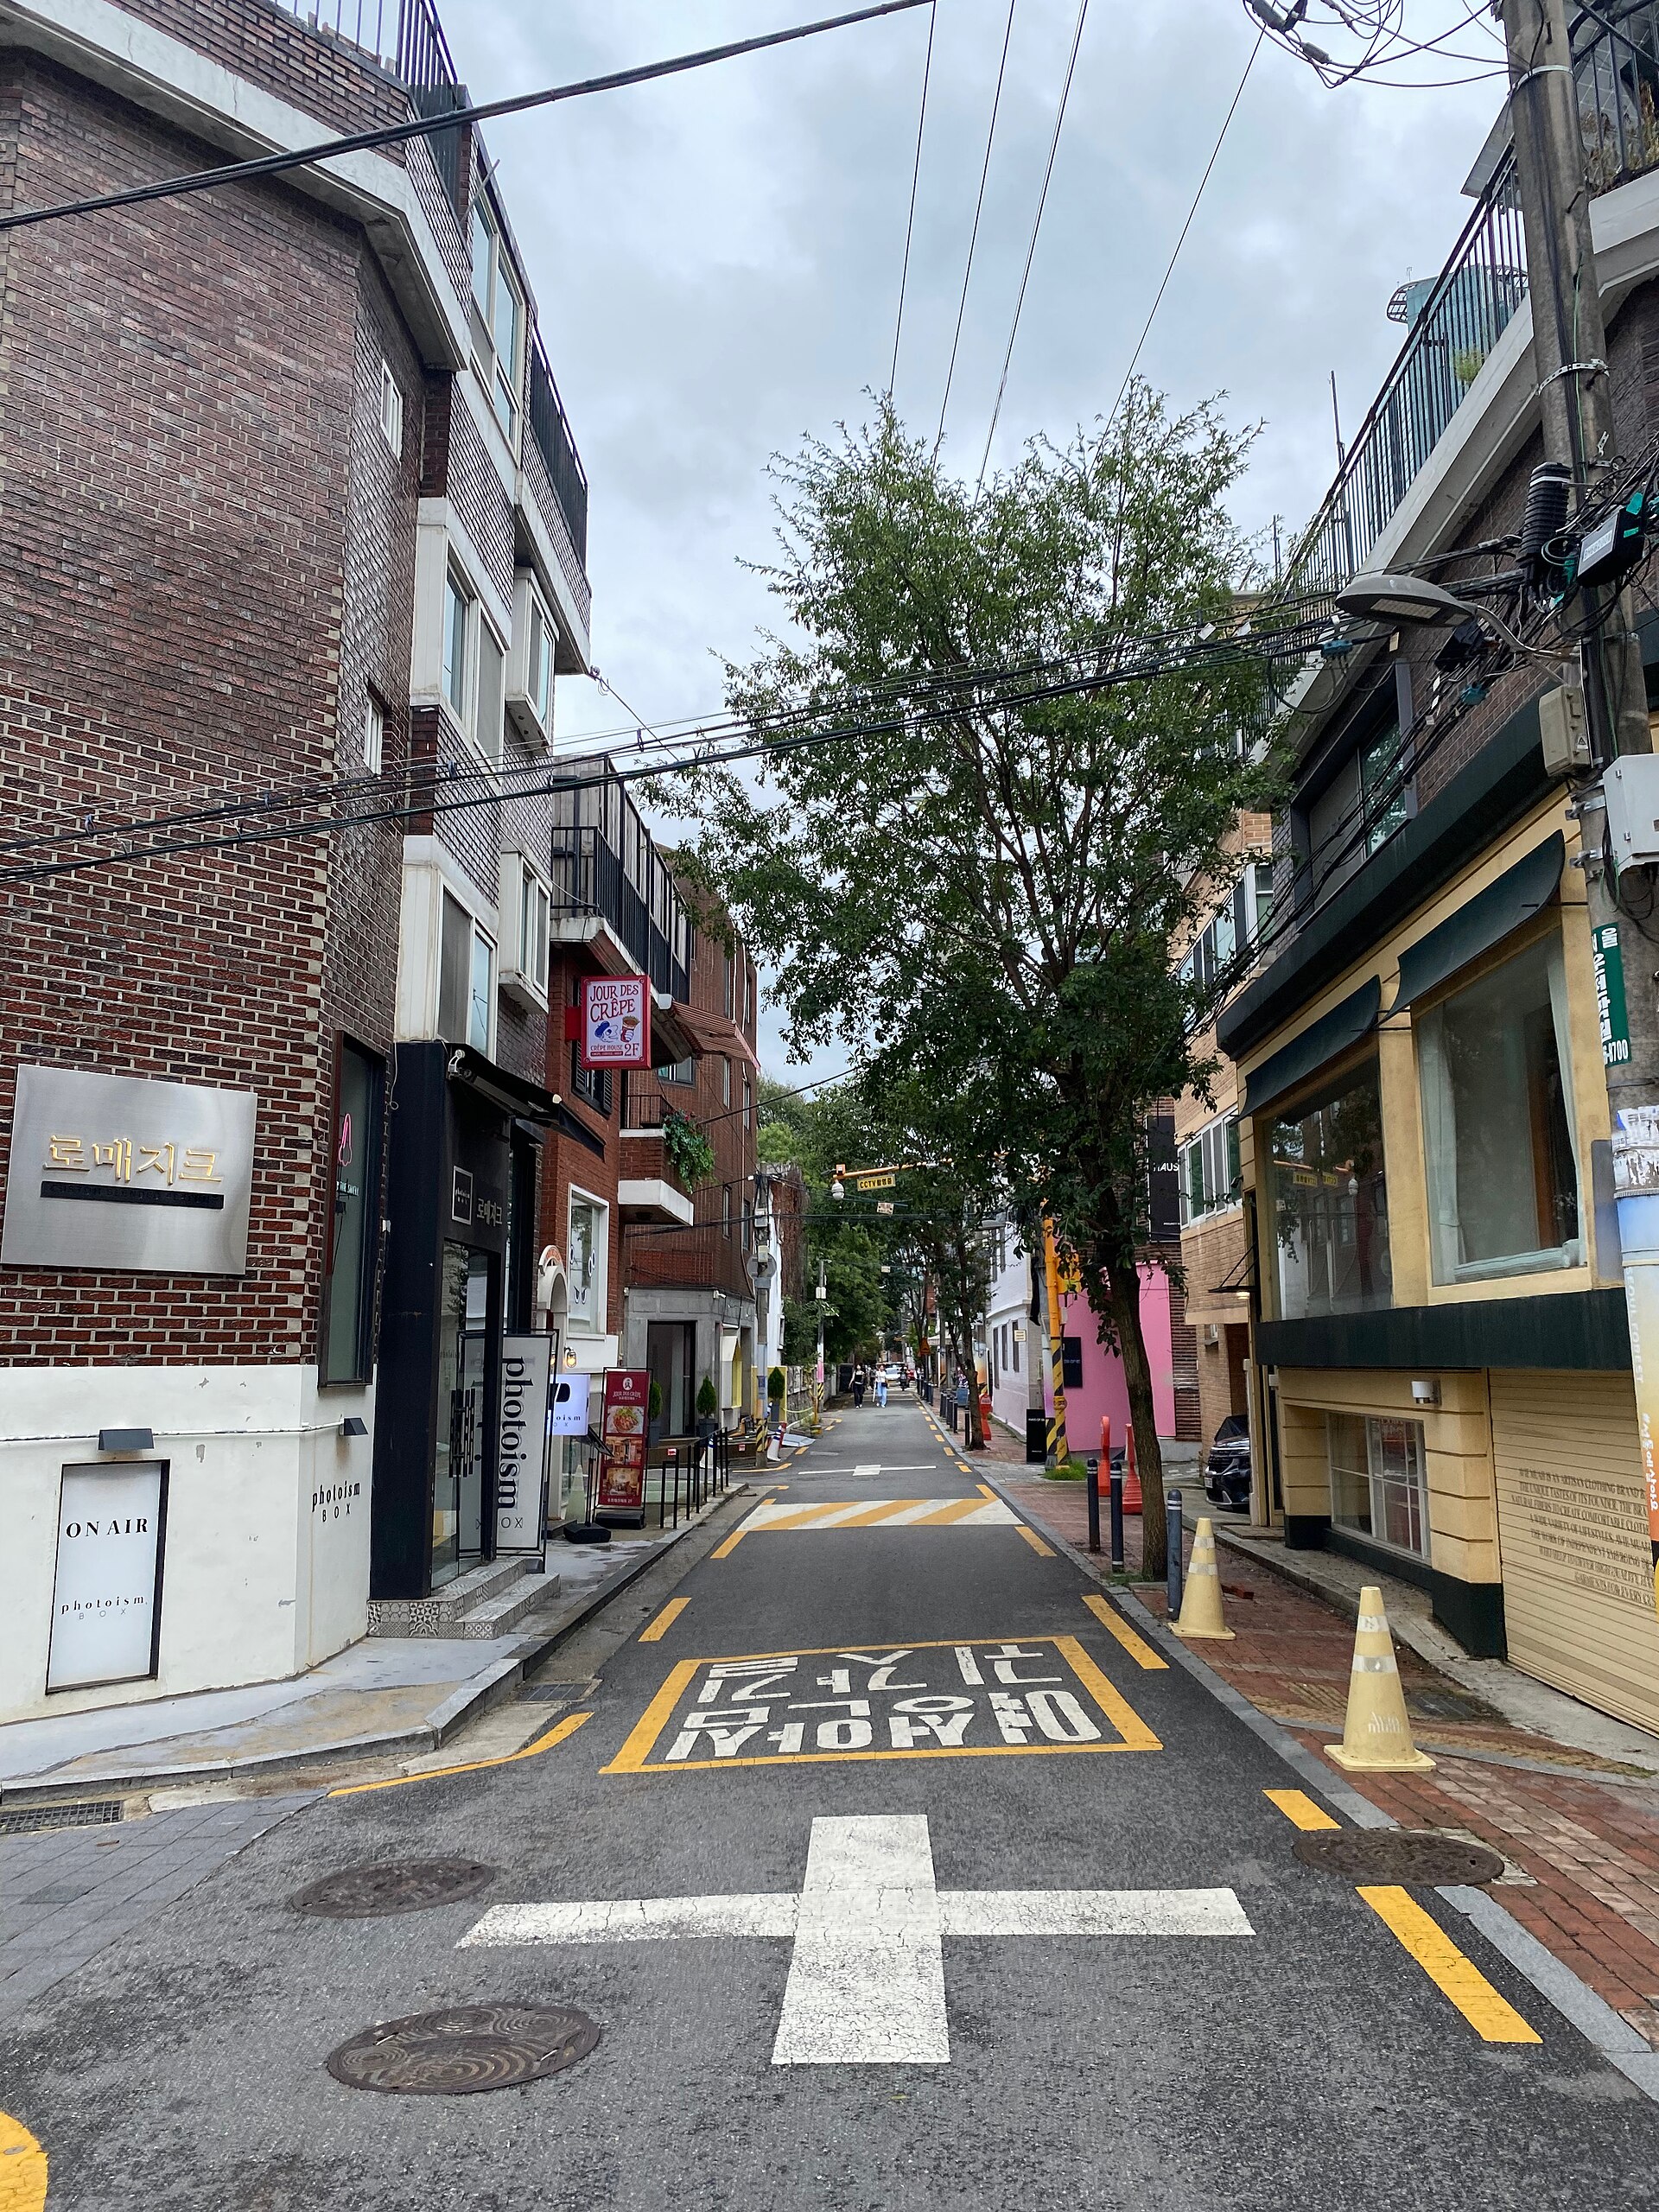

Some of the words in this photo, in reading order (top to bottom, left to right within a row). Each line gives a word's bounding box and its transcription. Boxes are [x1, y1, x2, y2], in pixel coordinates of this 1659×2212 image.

[590, 985, 618, 1001] JOUR
[618, 984, 639, 996] DES
[590, 998, 635, 1022] CRÊPE
[624, 1043, 639, 1056] 2F
[42, 1135, 224, 1185] 로매지크
[1631, 1323, 1643, 1383] FOREST
[498, 1357, 534, 1510] photoism
[312, 1480, 360, 1512] photoism
[321, 1503, 351, 1522] BOX
[66, 1521, 99, 1538] ON
[107, 1518, 148, 1535] AIR
[60, 1596, 144, 1615] photoism
[79, 1608, 127, 1619] BOX
[664, 1689, 1102, 1762] 여성안심
